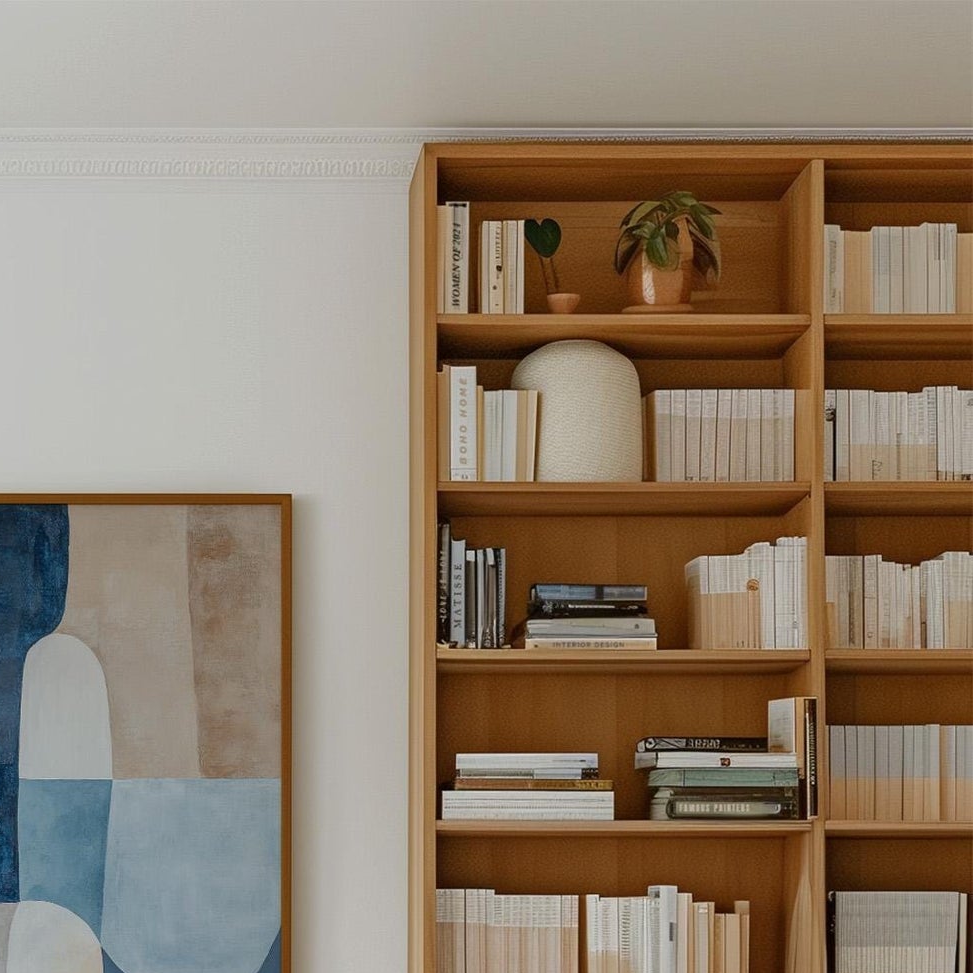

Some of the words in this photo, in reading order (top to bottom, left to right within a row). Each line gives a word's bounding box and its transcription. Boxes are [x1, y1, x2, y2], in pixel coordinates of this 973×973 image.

[451, 246, 461, 262] OF
[451, 264, 461, 307] WOMEN
[459, 377, 468, 418] HOME
[459, 424, 468, 465] BOHO
[453, 563, 462, 629] MATISSE
[678, 803, 710, 812] FAMOUS
[713, 803, 750, 812] PAINTERS
